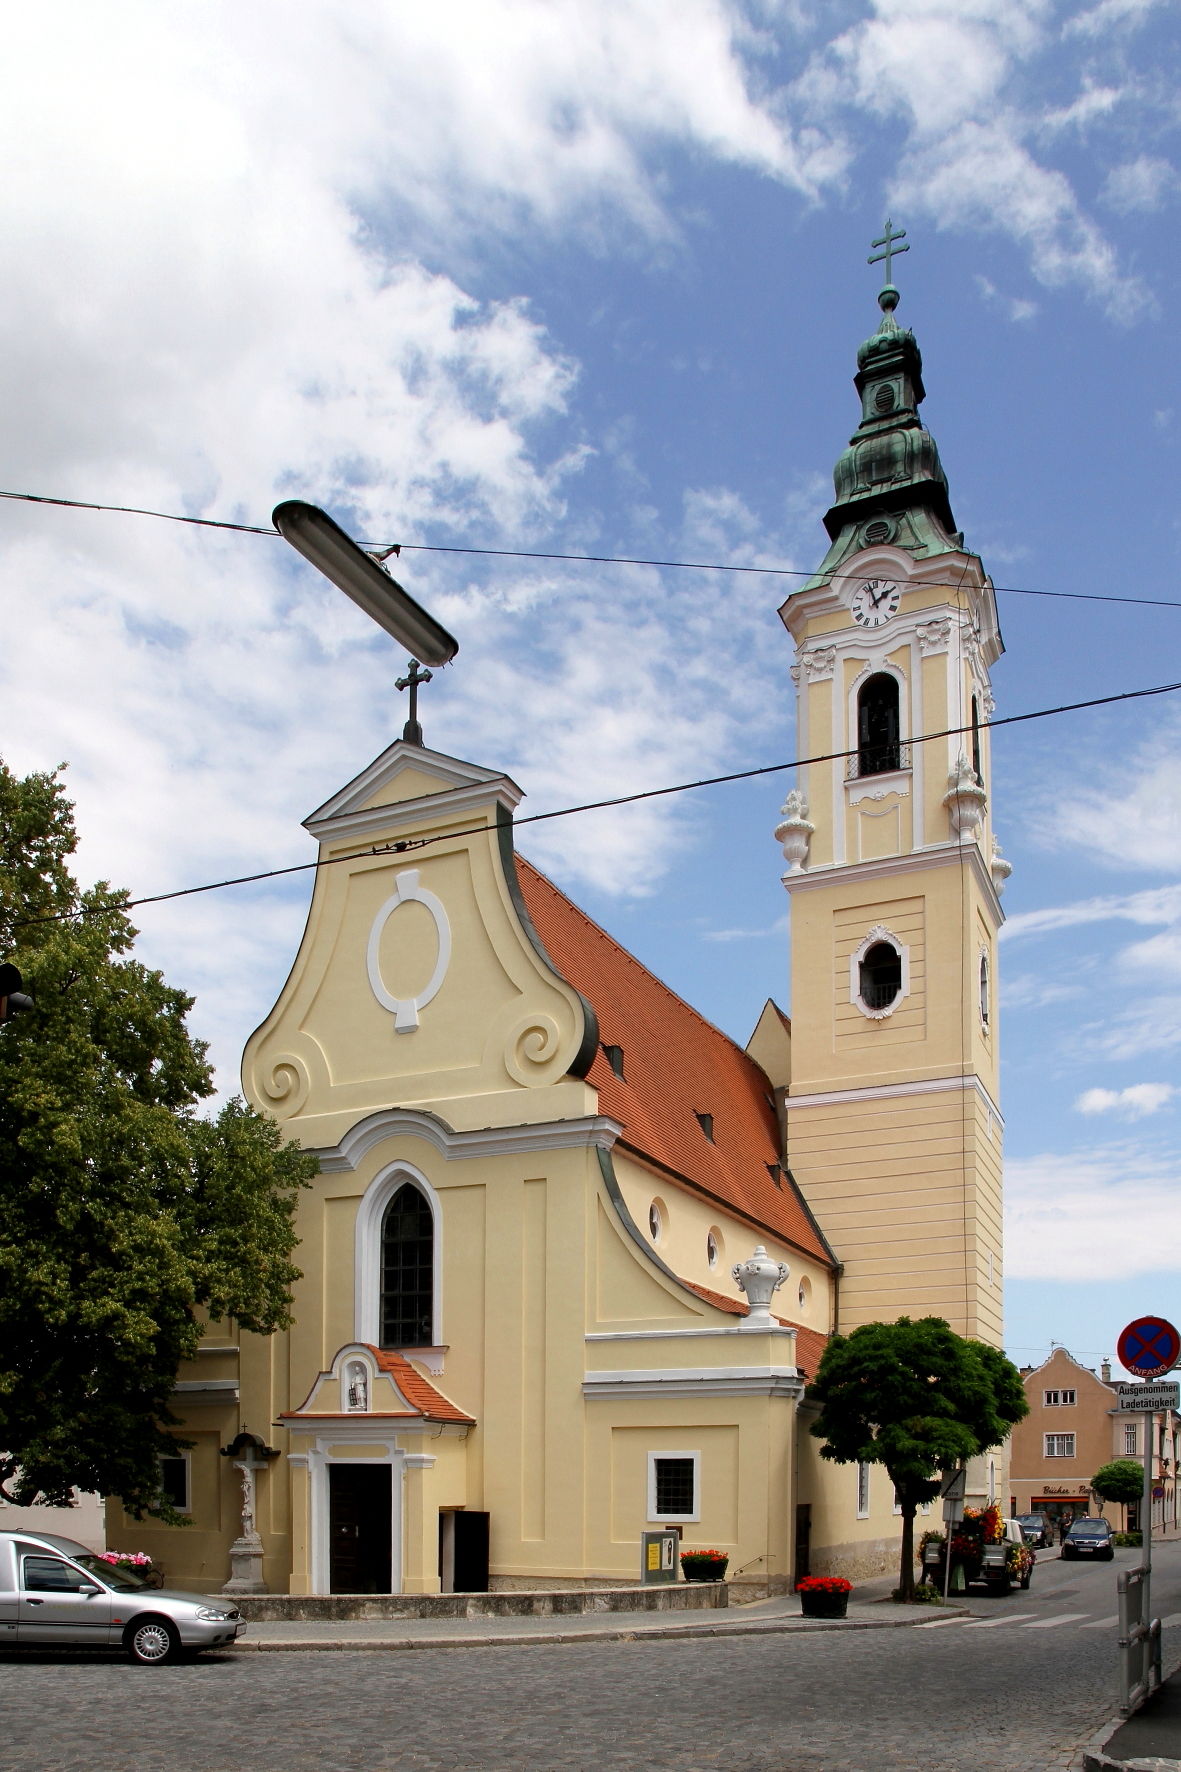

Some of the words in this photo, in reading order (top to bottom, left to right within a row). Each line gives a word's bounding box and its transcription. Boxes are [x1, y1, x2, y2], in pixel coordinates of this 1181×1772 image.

[1128, 1364, 1168, 1376] ANFANG
[1119, 1385, 1178, 1397] Ausgenommen
[1121, 1397, 1176, 1409] Ladetätigkeit
[1043, 1485, 1070, 1494] Bücher
